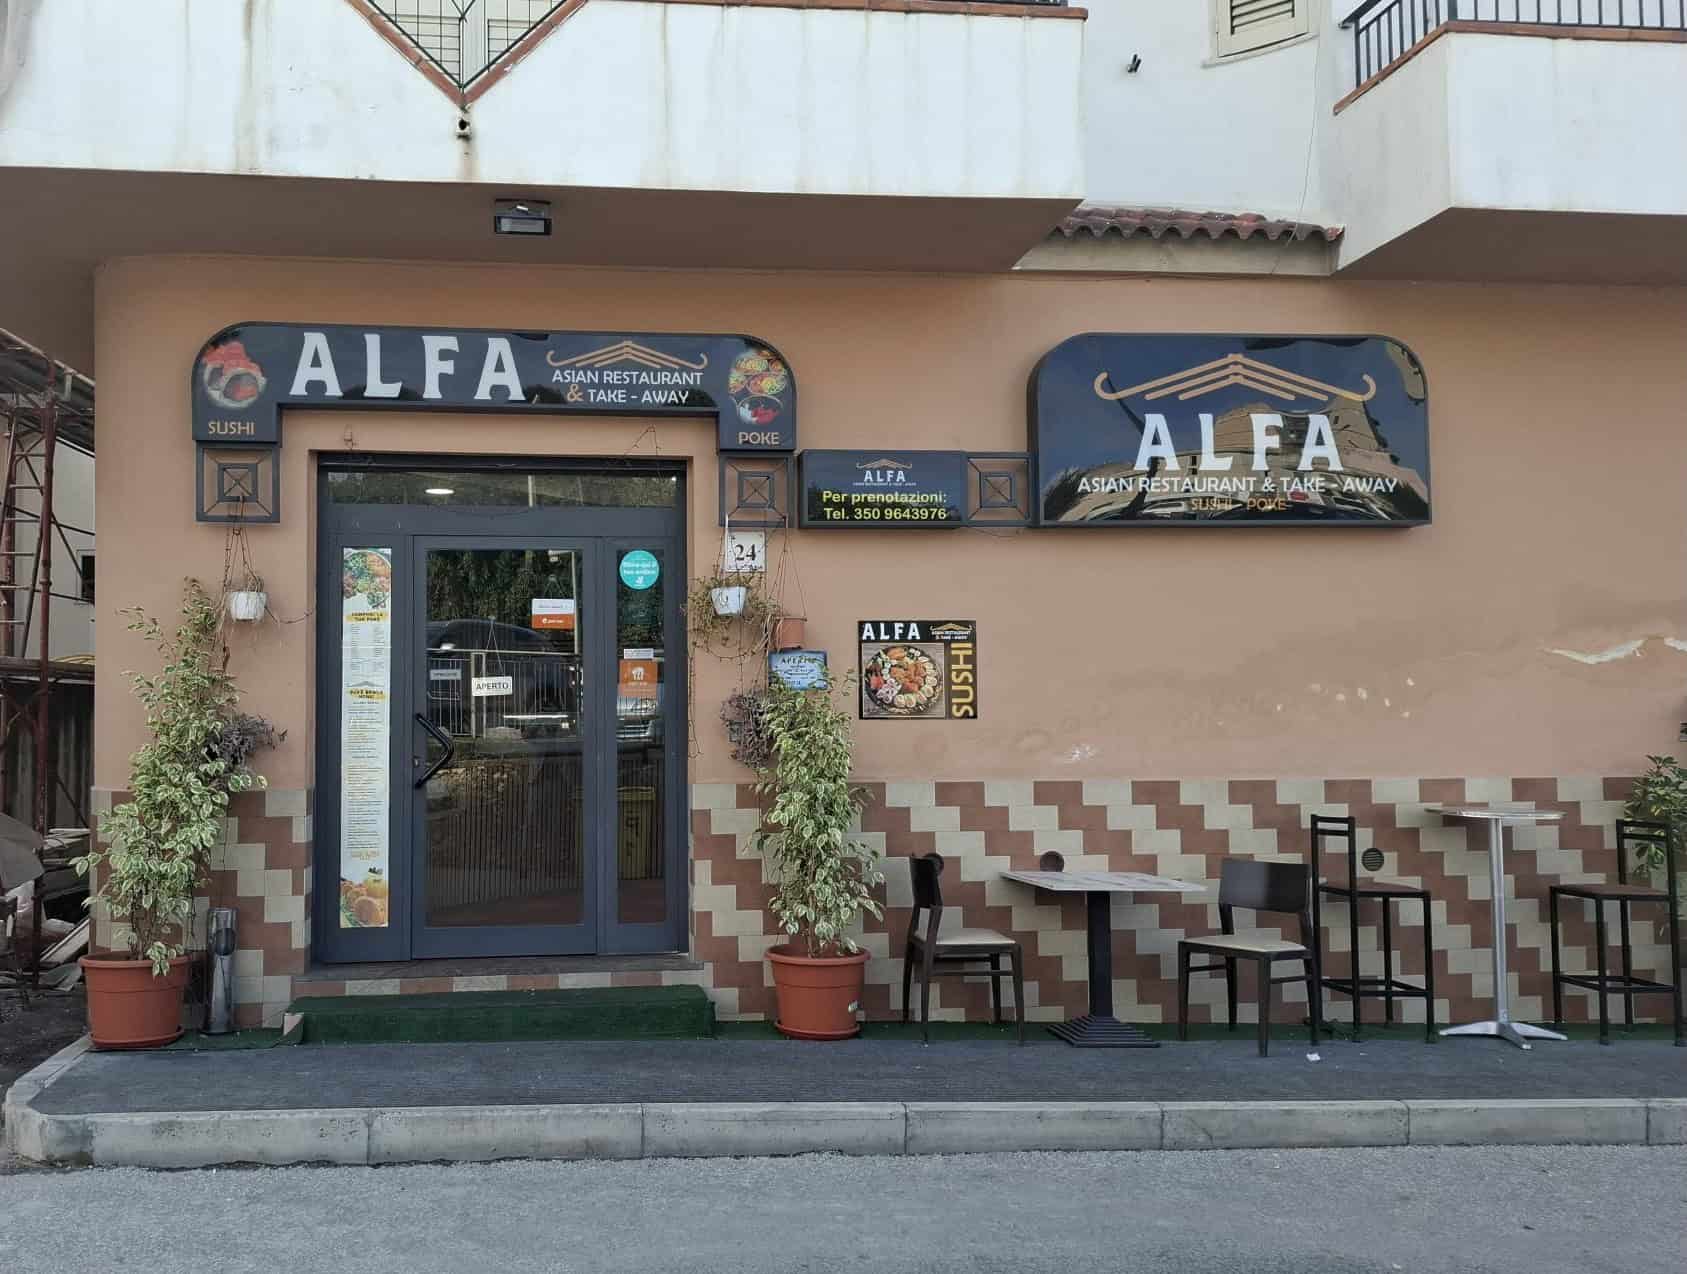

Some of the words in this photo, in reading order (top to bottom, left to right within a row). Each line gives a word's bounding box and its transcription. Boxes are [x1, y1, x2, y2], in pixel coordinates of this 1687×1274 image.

[289, 331, 526, 401] ALFA
[551, 368, 598, 384] ASIAN
[603, 370, 704, 386] RESTAURANT
[566, 383, 583, 402] &
[588, 388, 626, 403] TAKE
[642, 389, 689, 405] AWAY
[207, 420, 256, 436] SUSHI
[737, 431, 780, 446] POKE
[1133, 413, 1344, 471] ALFA
[863, 470, 906, 482] ALFA
[1078, 477, 1135, 492] ASIAN
[1138, 477, 1256, 492] RESTAURANT
[1262, 477, 1276, 492] &
[1280, 477, 1325, 492] TAKE
[1343, 477, 1398, 493] AWAY
[822, 490, 848, 503] Per
[851, 490, 948, 505] prenotazioni:
[1191, 498, 1232, 511] SUSHI
[1247, 498, 1286, 511] POKE
[823, 507, 850, 520] Tel.
[854, 507, 881, 520] 350
[884, 507, 947, 520] 9643976
[735, 543, 756, 561] 24
[862, 622, 920, 640] ALFA
[476, 682, 509, 691] APERTO
[951, 643, 974, 717] SUSHI
